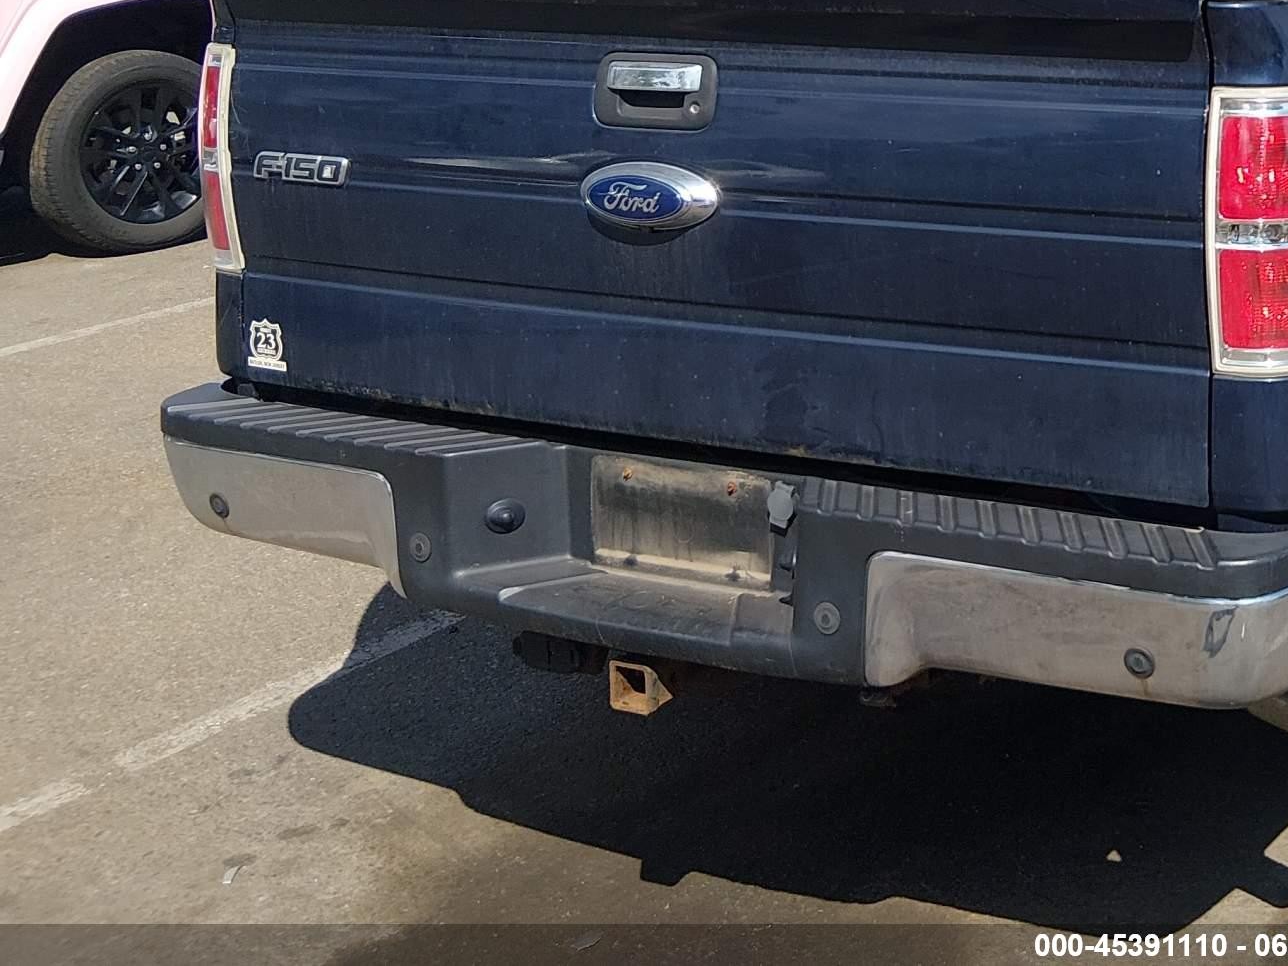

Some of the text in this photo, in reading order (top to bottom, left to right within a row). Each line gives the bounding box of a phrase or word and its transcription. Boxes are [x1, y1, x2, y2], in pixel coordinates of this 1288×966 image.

[253, 151, 349, 186] F-150
[603, 181, 662, 213] Ford
[256, 332, 276, 349] 23
